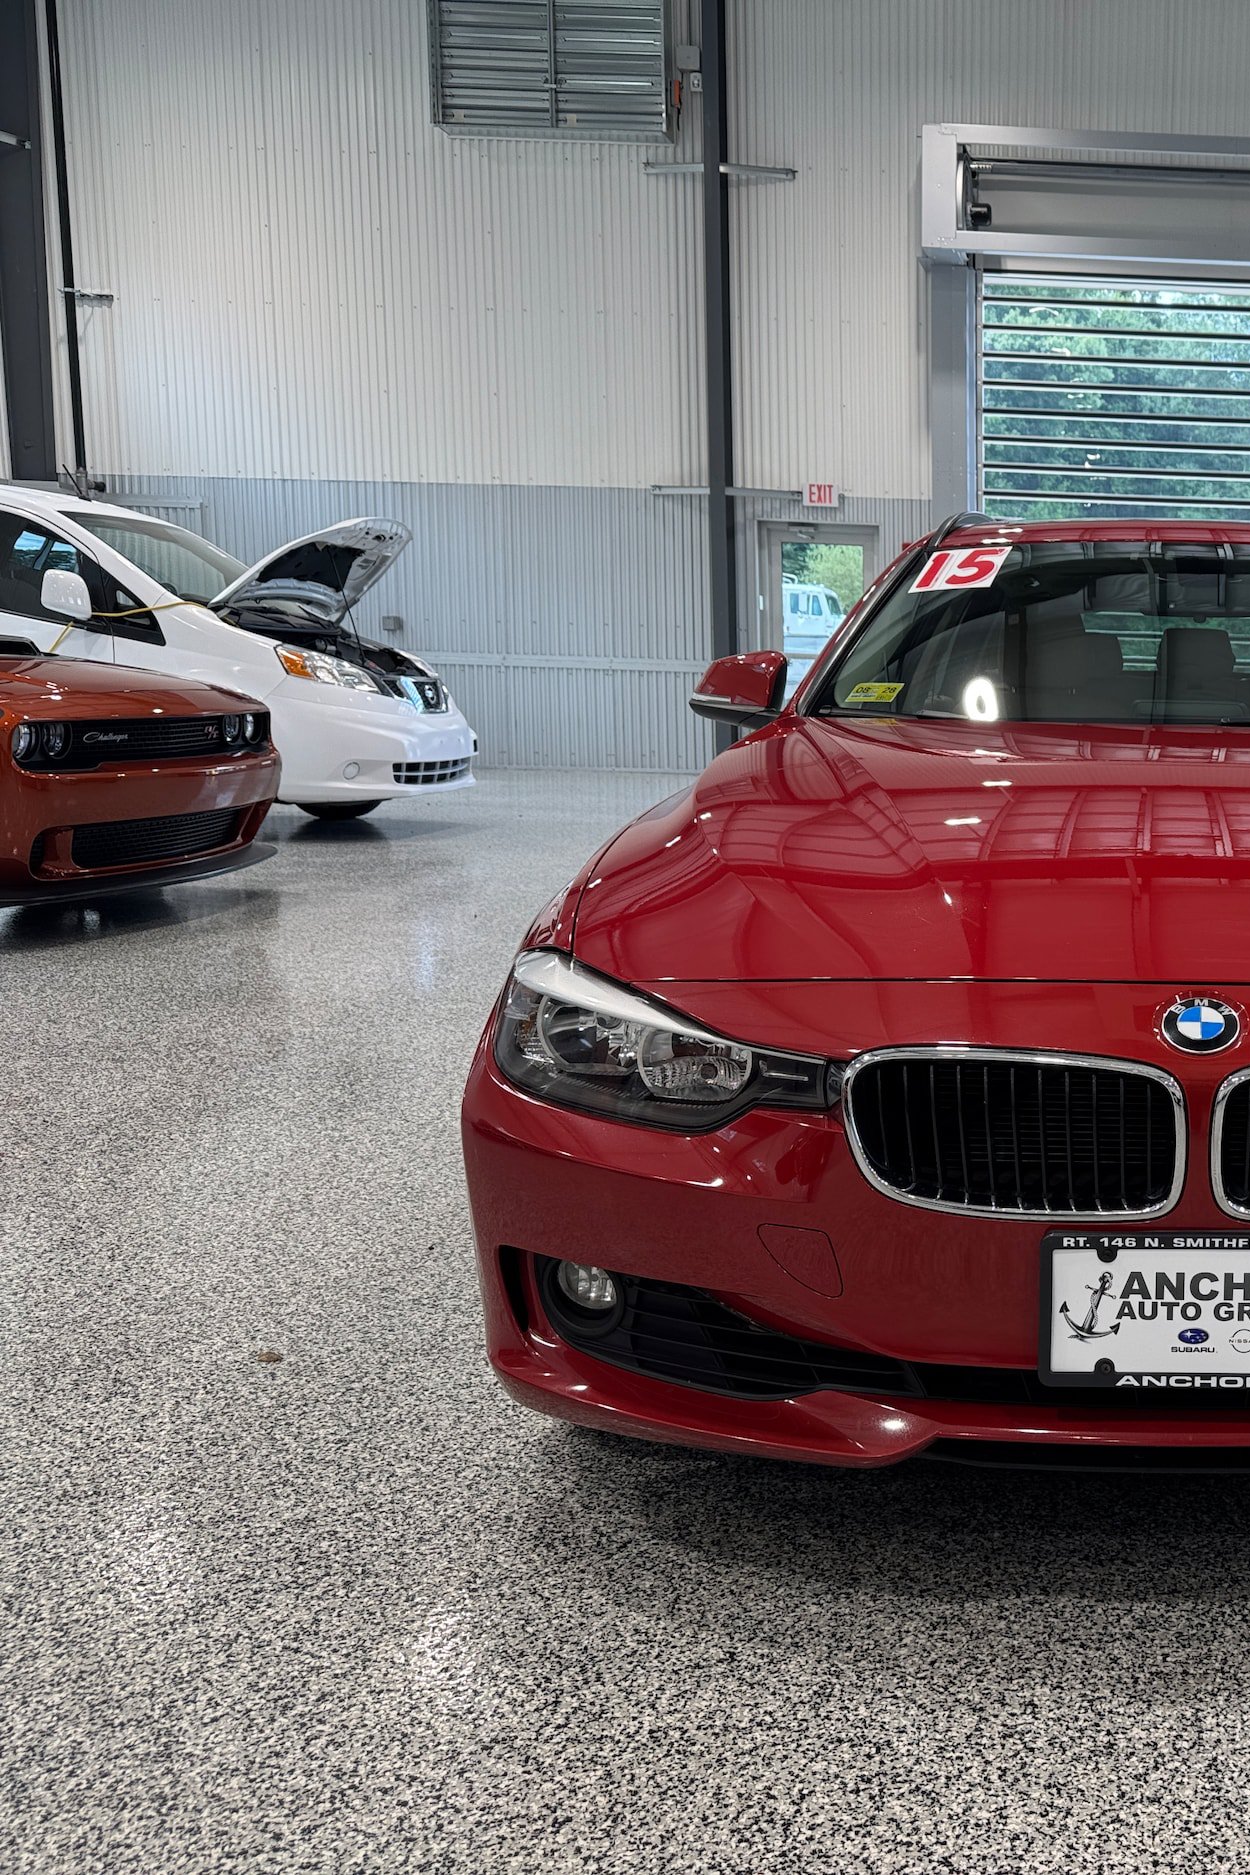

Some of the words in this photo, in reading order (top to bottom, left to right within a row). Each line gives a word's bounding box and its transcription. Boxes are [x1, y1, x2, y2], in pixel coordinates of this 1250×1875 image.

[808, 483, 834, 504] EXIT
[915, 548, 1006, 589] 15
[1170, 998, 1234, 1015] BMW
[1062, 1237, 1090, 1248] RT.
[1099, 1236, 1137, 1248] 146
[1144, 1237, 1165, 1248] N.
[1115, 1301, 1202, 1320] AUTO
